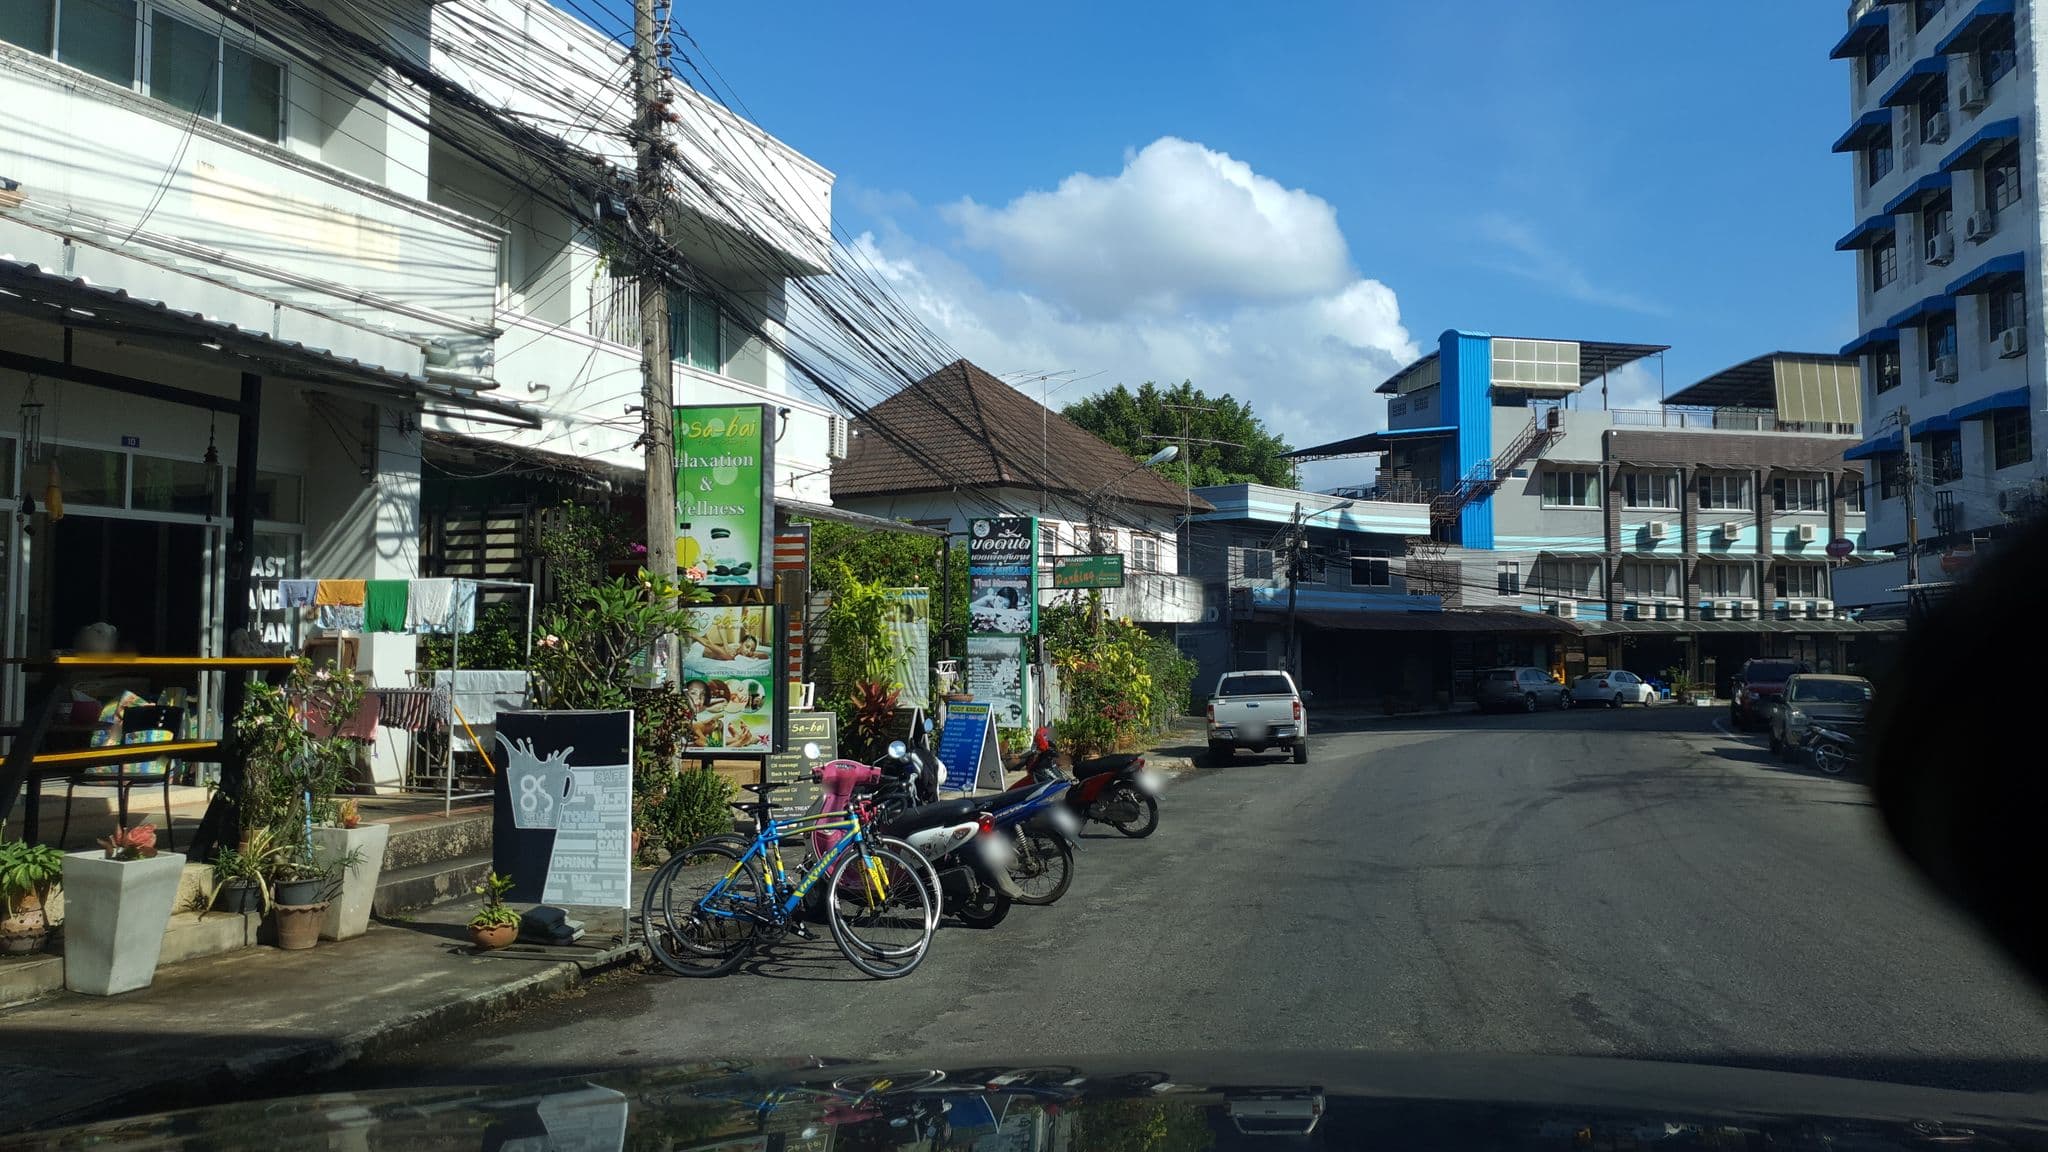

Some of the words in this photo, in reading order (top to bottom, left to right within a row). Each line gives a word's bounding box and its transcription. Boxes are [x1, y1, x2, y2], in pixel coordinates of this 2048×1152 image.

[674, 452, 753, 467] elaxation
[700, 476, 713, 491] &
[250, 556, 285, 577] AST
[554, 857, 596, 868] DRINK
